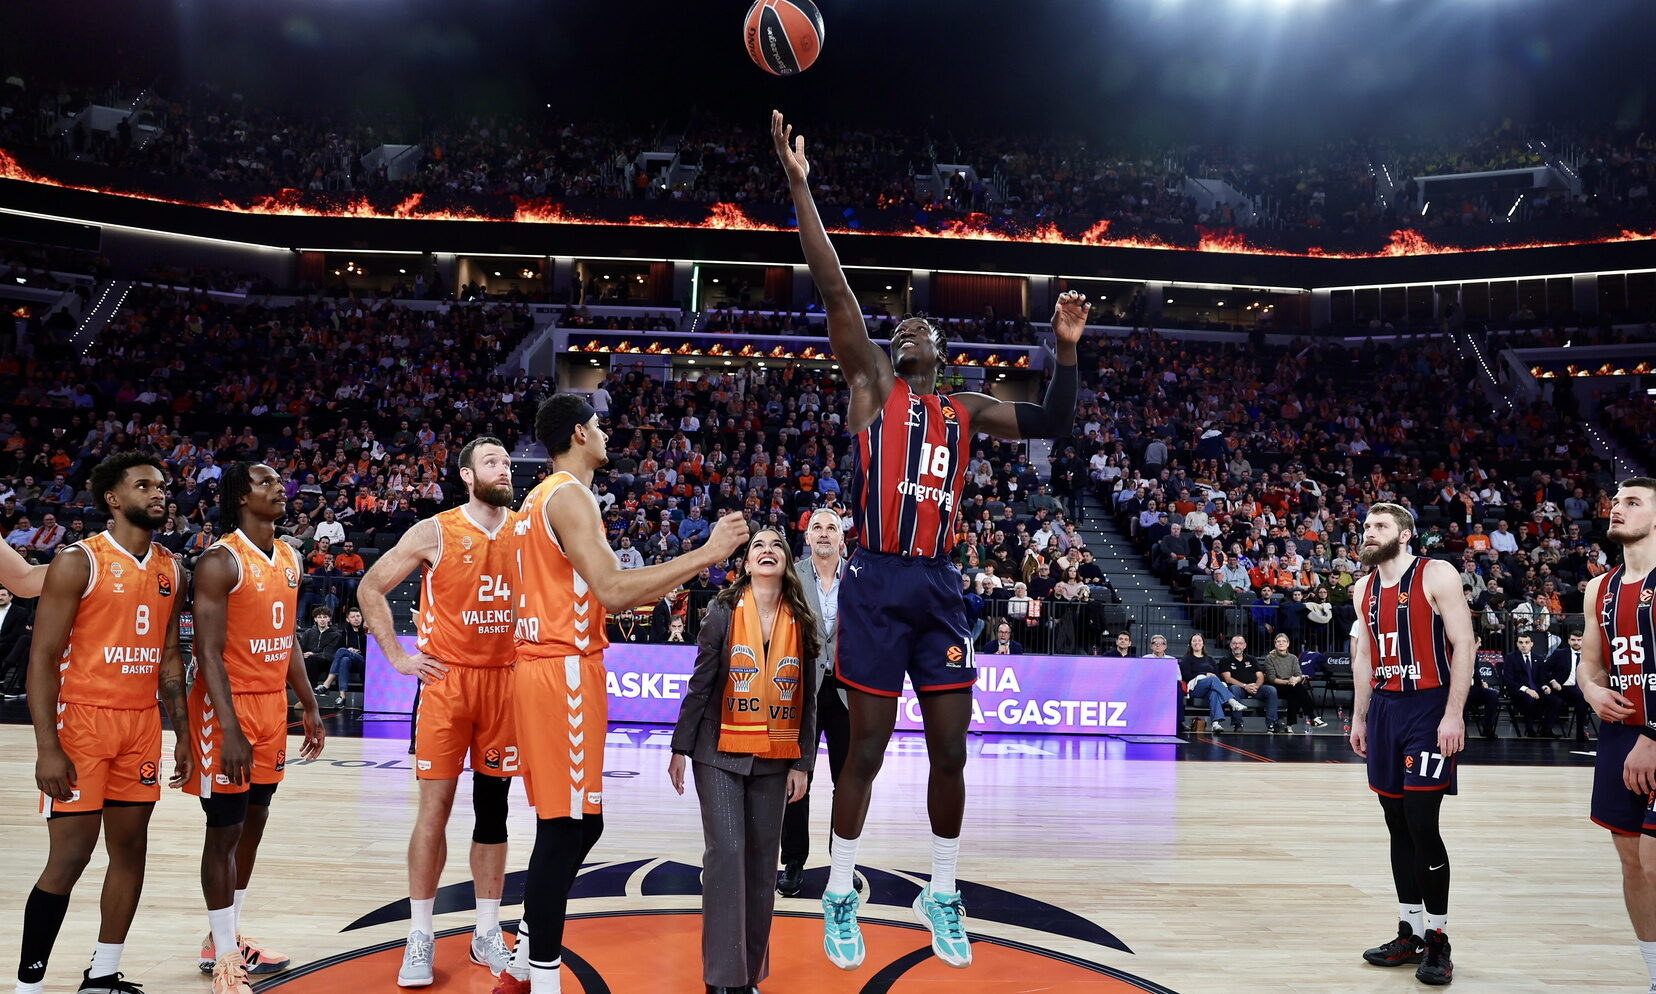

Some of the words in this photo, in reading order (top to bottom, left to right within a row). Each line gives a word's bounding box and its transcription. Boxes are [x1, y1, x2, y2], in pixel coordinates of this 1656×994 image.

[920, 442, 950, 479] 18
[478, 574, 511, 602] 24
[135, 604, 150, 635] 8
[272, 601, 284, 630] 0
[478, 625, 510, 634] BASKET
[103, 646, 162, 664] VALENCI
[1378, 631, 1398, 658] 17
[1611, 634, 1645, 666] 25
[121, 664, 154, 674] BASKET
[973, 667, 1021, 693] NIA
[605, 671, 693, 699] ASKET
[727, 697, 760, 712] VBC
[769, 705, 797, 720] VBC
[502, 745, 519, 772] 2
[1419, 750, 1446, 779] 17
